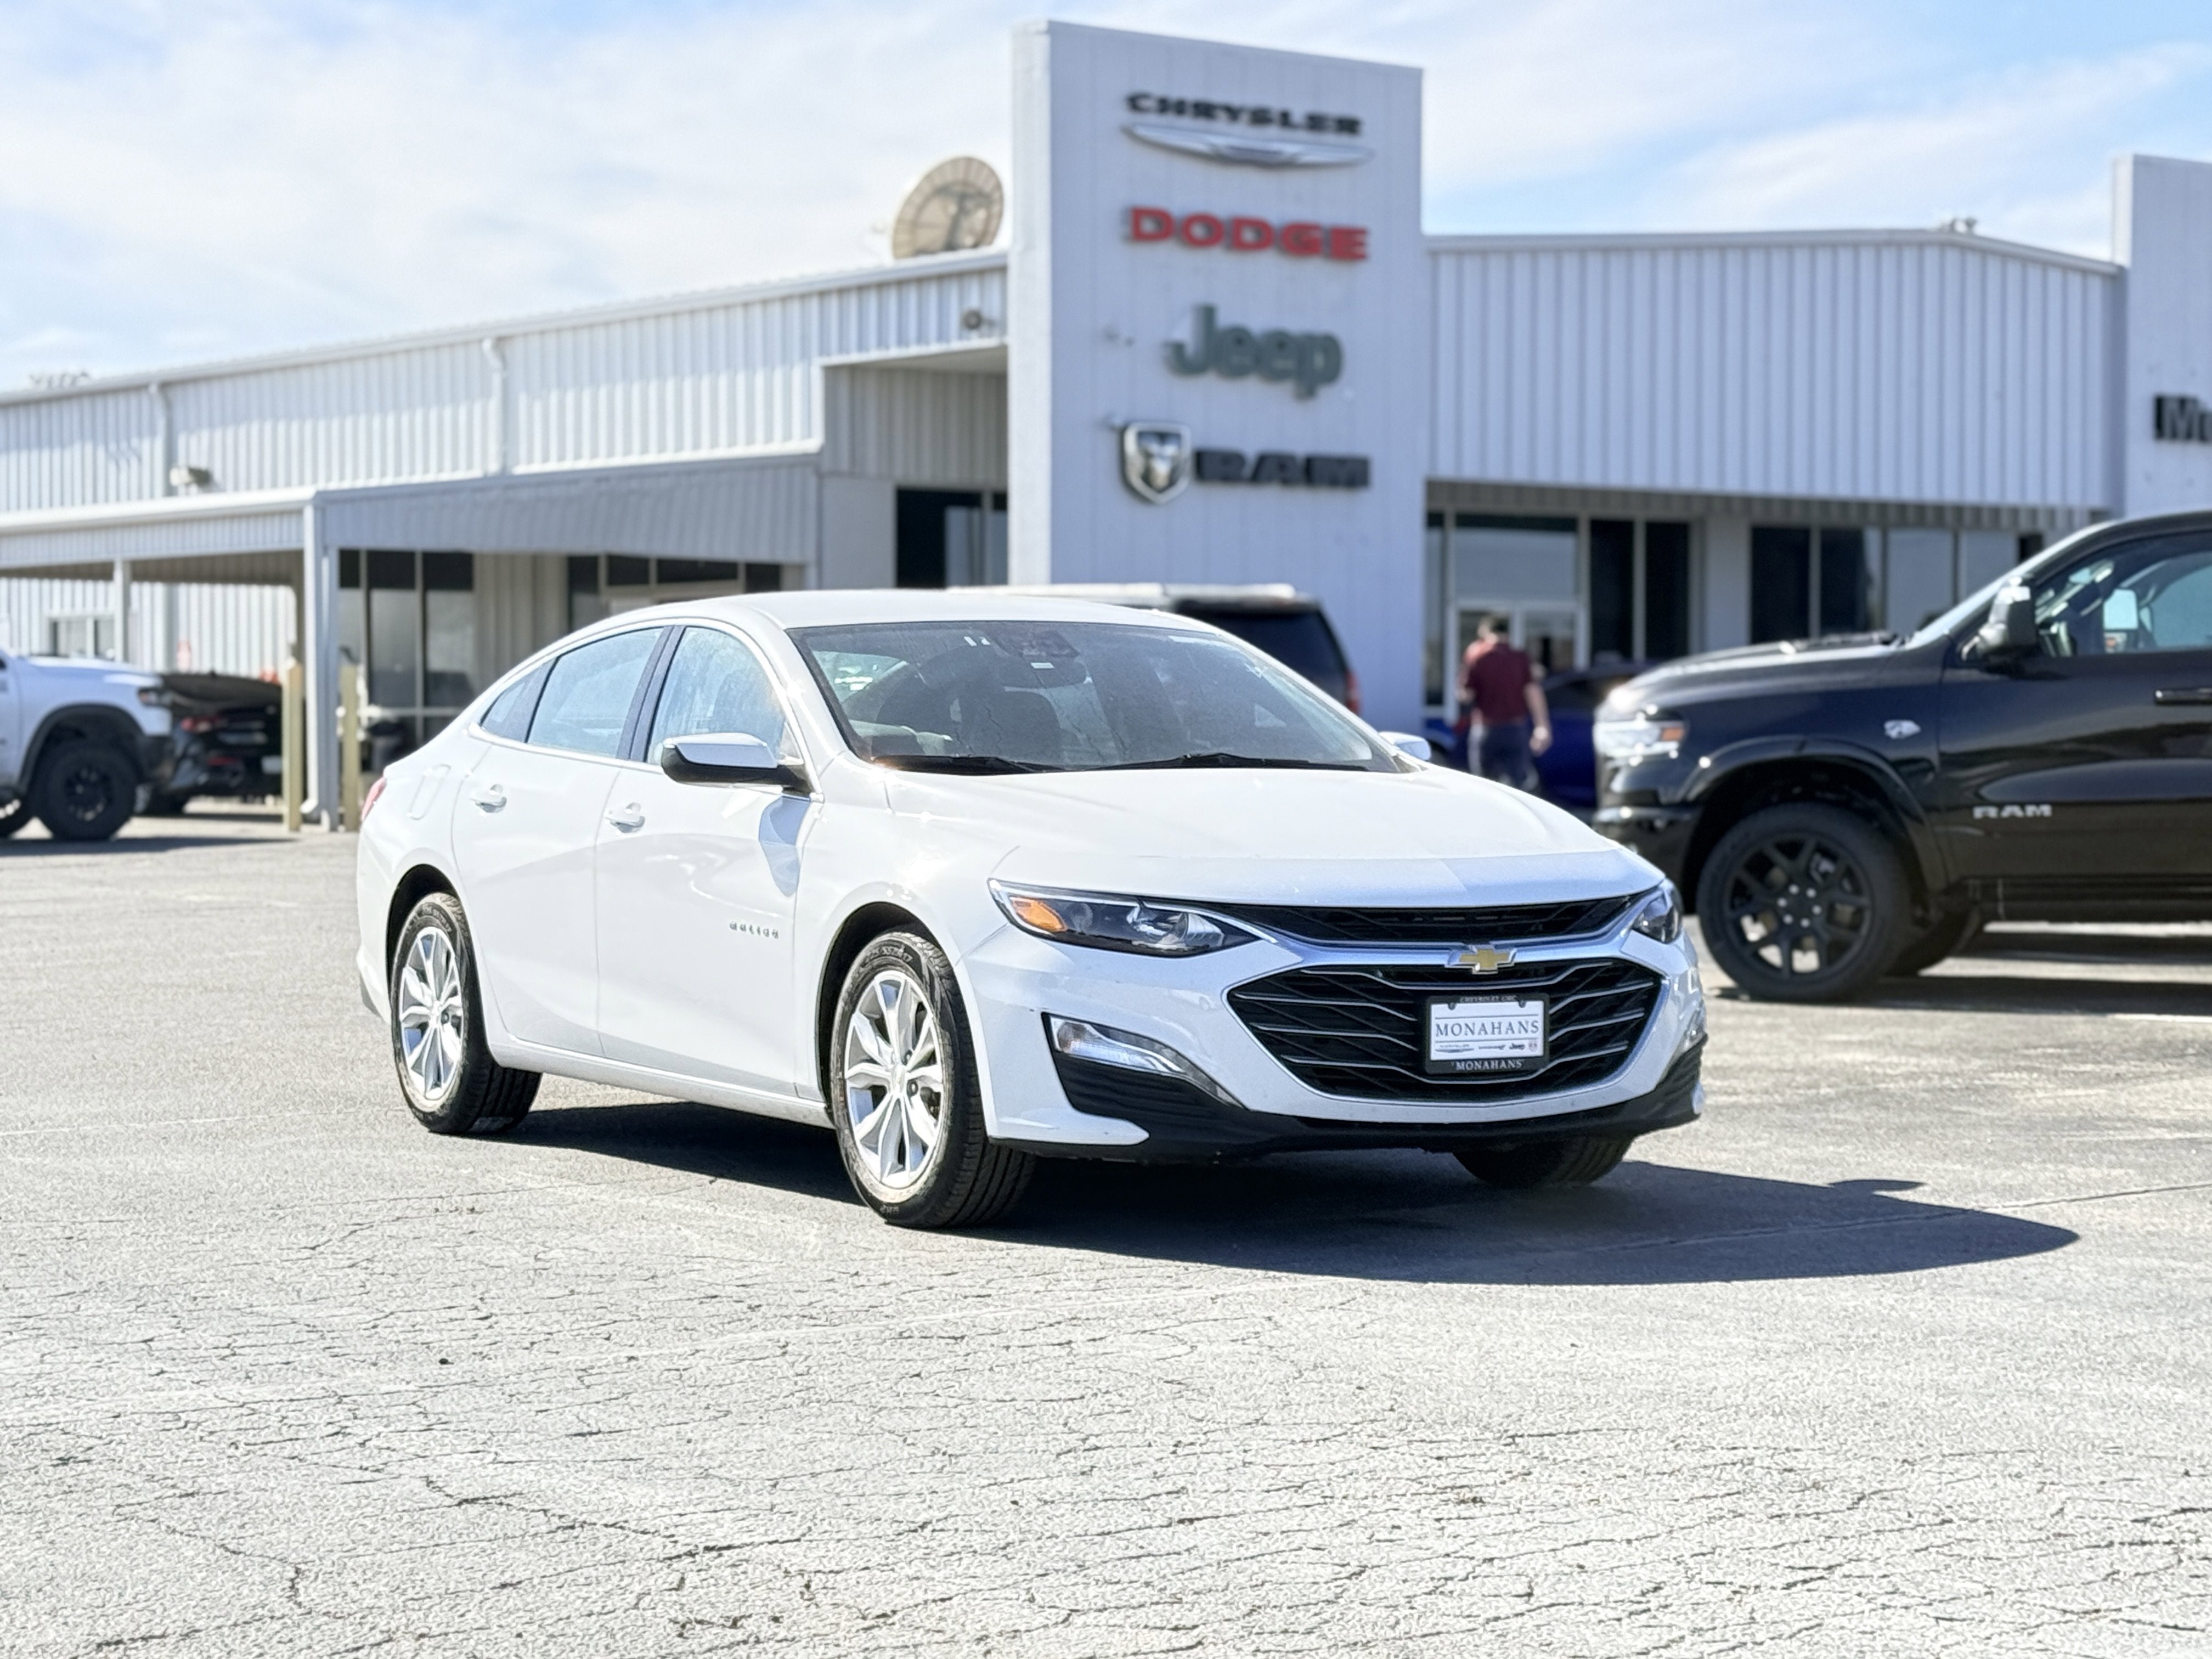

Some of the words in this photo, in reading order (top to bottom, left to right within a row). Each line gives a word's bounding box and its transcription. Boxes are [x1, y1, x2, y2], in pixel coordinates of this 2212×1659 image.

[1127, 92, 1363, 137] CHRYSLER
[1128, 206, 1369, 262] DODGE
[1163, 303, 1344, 402] Jeep
[1194, 449, 1370, 488] RAM
[1973, 804, 2052, 819] RAM
[1435, 1020, 1539, 1037] MONAHANS
